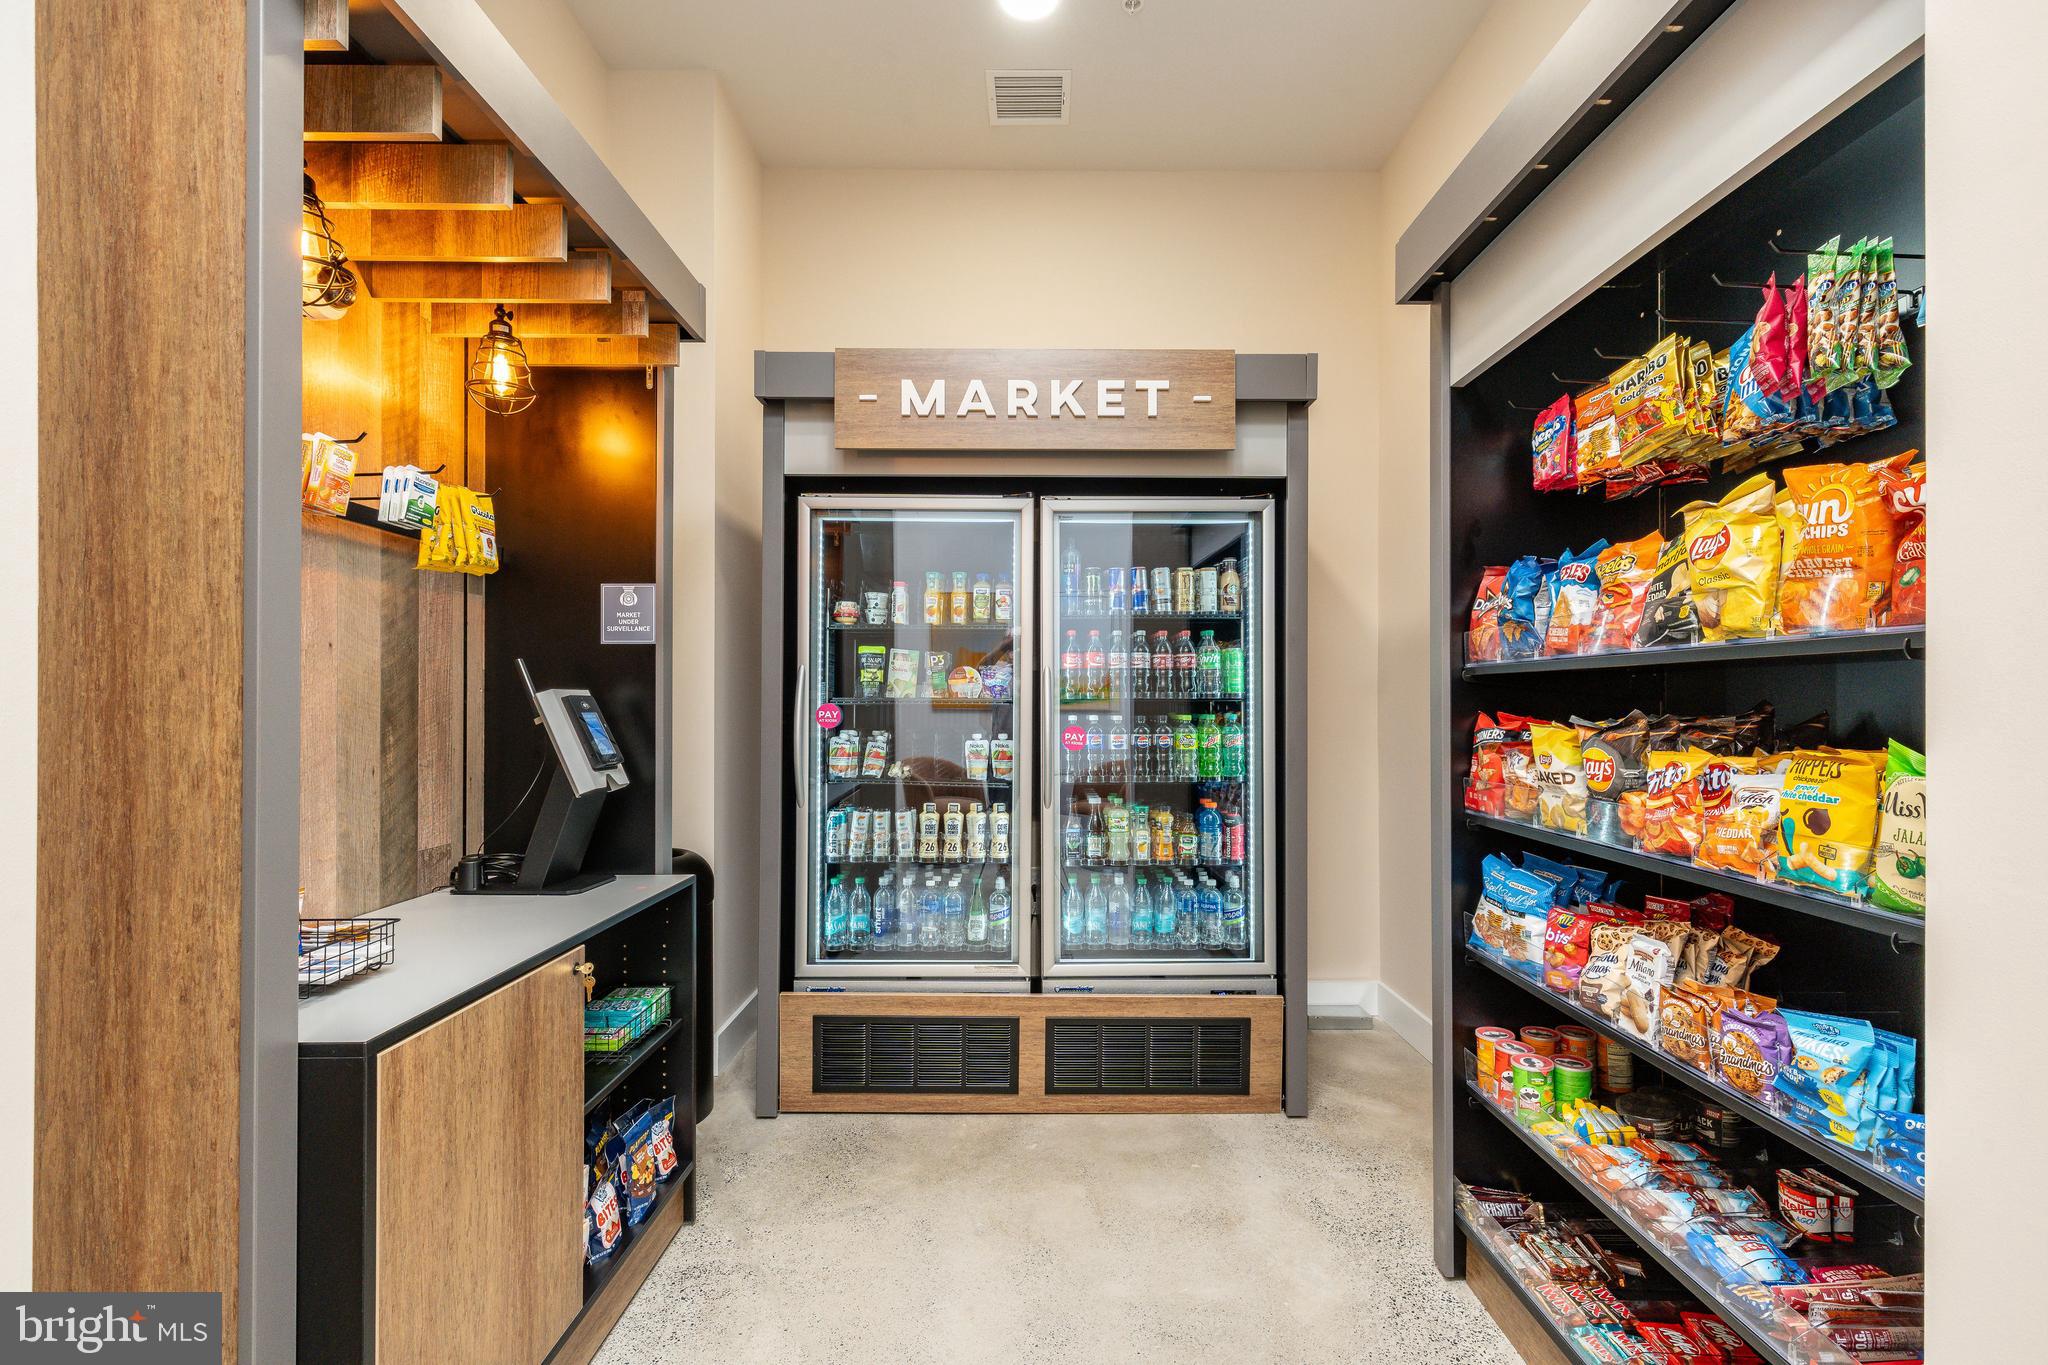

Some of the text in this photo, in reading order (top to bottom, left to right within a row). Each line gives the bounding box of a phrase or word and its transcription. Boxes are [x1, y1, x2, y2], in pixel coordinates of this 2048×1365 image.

[1613, 353, 1668, 396] HARIBO
[901, 378, 1170, 418] MARKET
[1698, 572, 1731, 587] Classic
[818, 710, 839, 719] PAY
[1064, 732, 1085, 741] PAY
[1798, 792, 1840, 804] cheddar
[1715, 826, 1753, 839] CHEDDAR
[925, 842, 935, 852] 26
[947, 842, 957, 852] 26
[998, 842, 1007, 852] 26
[874, 907, 882, 934] smart
[1557, 913, 1576, 927] RITZ
[1545, 927, 1570, 945] bits
[1628, 958, 1655, 978] Milano
[1719, 1047, 1775, 1077] Grandma's
[1763, 1091, 1772, 1101] 2
[653, 1132, 673, 1156] BITES
[597, 1195, 618, 1228] BITES
[1536, 1282, 1575, 1316] TWIX
[1563, 1283, 1603, 1318] TWIX
[1591, 1285, 1632, 1319] TWIX
